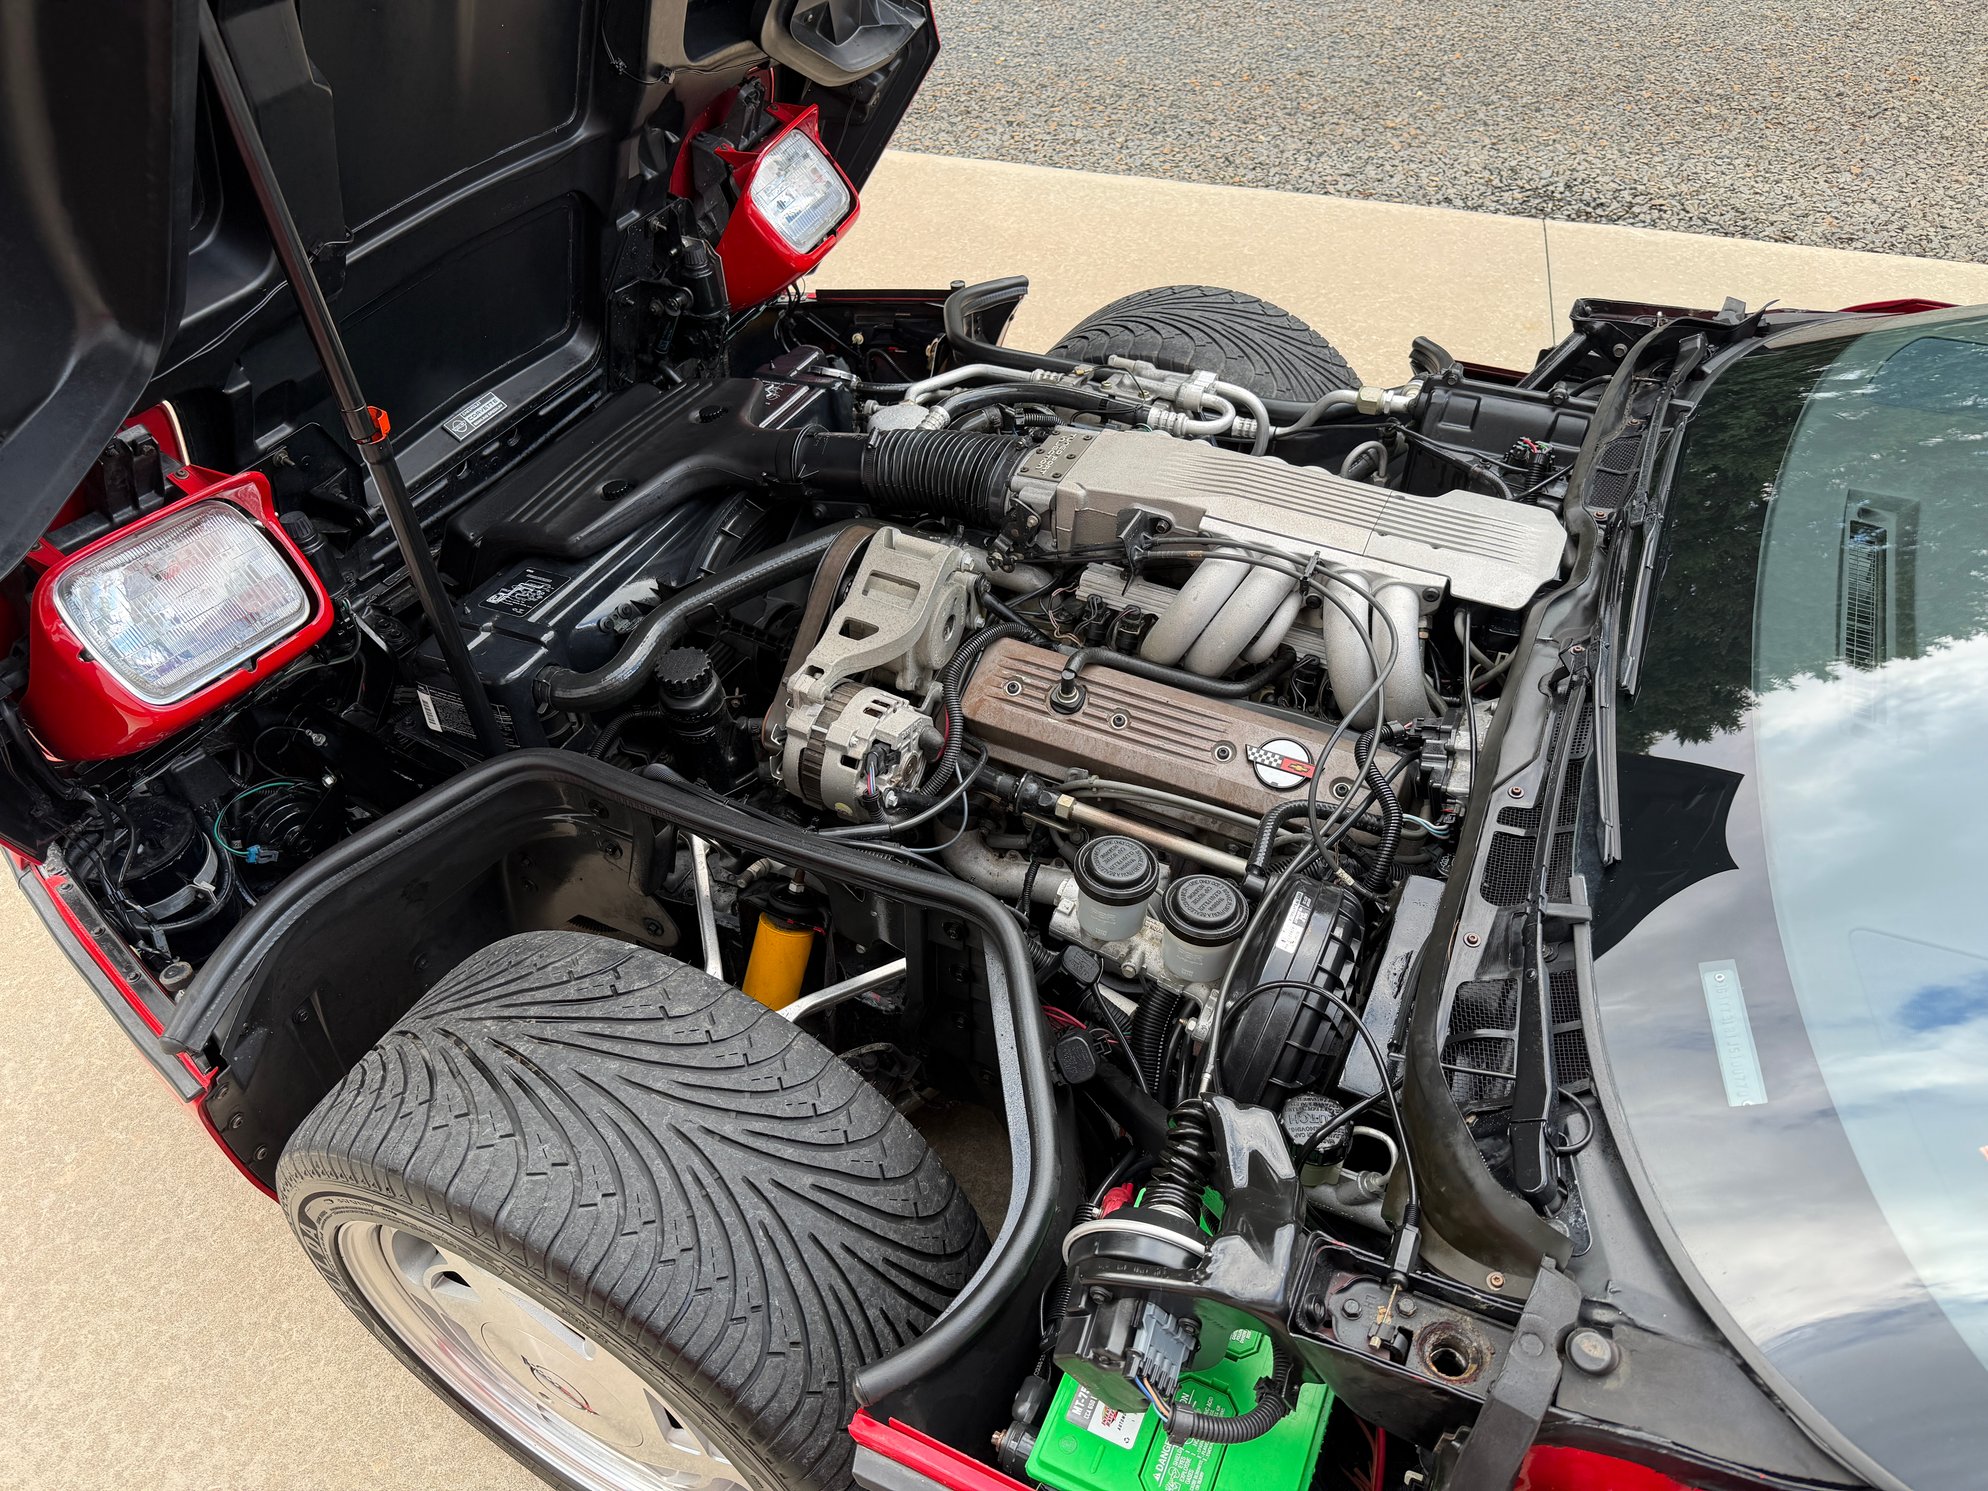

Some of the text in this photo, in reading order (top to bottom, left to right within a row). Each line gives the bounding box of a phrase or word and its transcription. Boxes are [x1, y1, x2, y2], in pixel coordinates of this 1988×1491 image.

[467, 399, 498, 421] CORVETTE
[1035, 436, 1068, 470] INJECTION
[1040, 434, 1077, 476] TUNED PORT
[1288, 1112, 1331, 1124] UTCH
[299, 1222, 364, 1314] FULDA
[1083, 1400, 1096, 1420] CCA 650
[1117, 1414, 1127, 1431] AUTOM
[1155, 1437, 1172, 1472] DANGE
[1172, 1447, 1183, 1467] SHIELD
